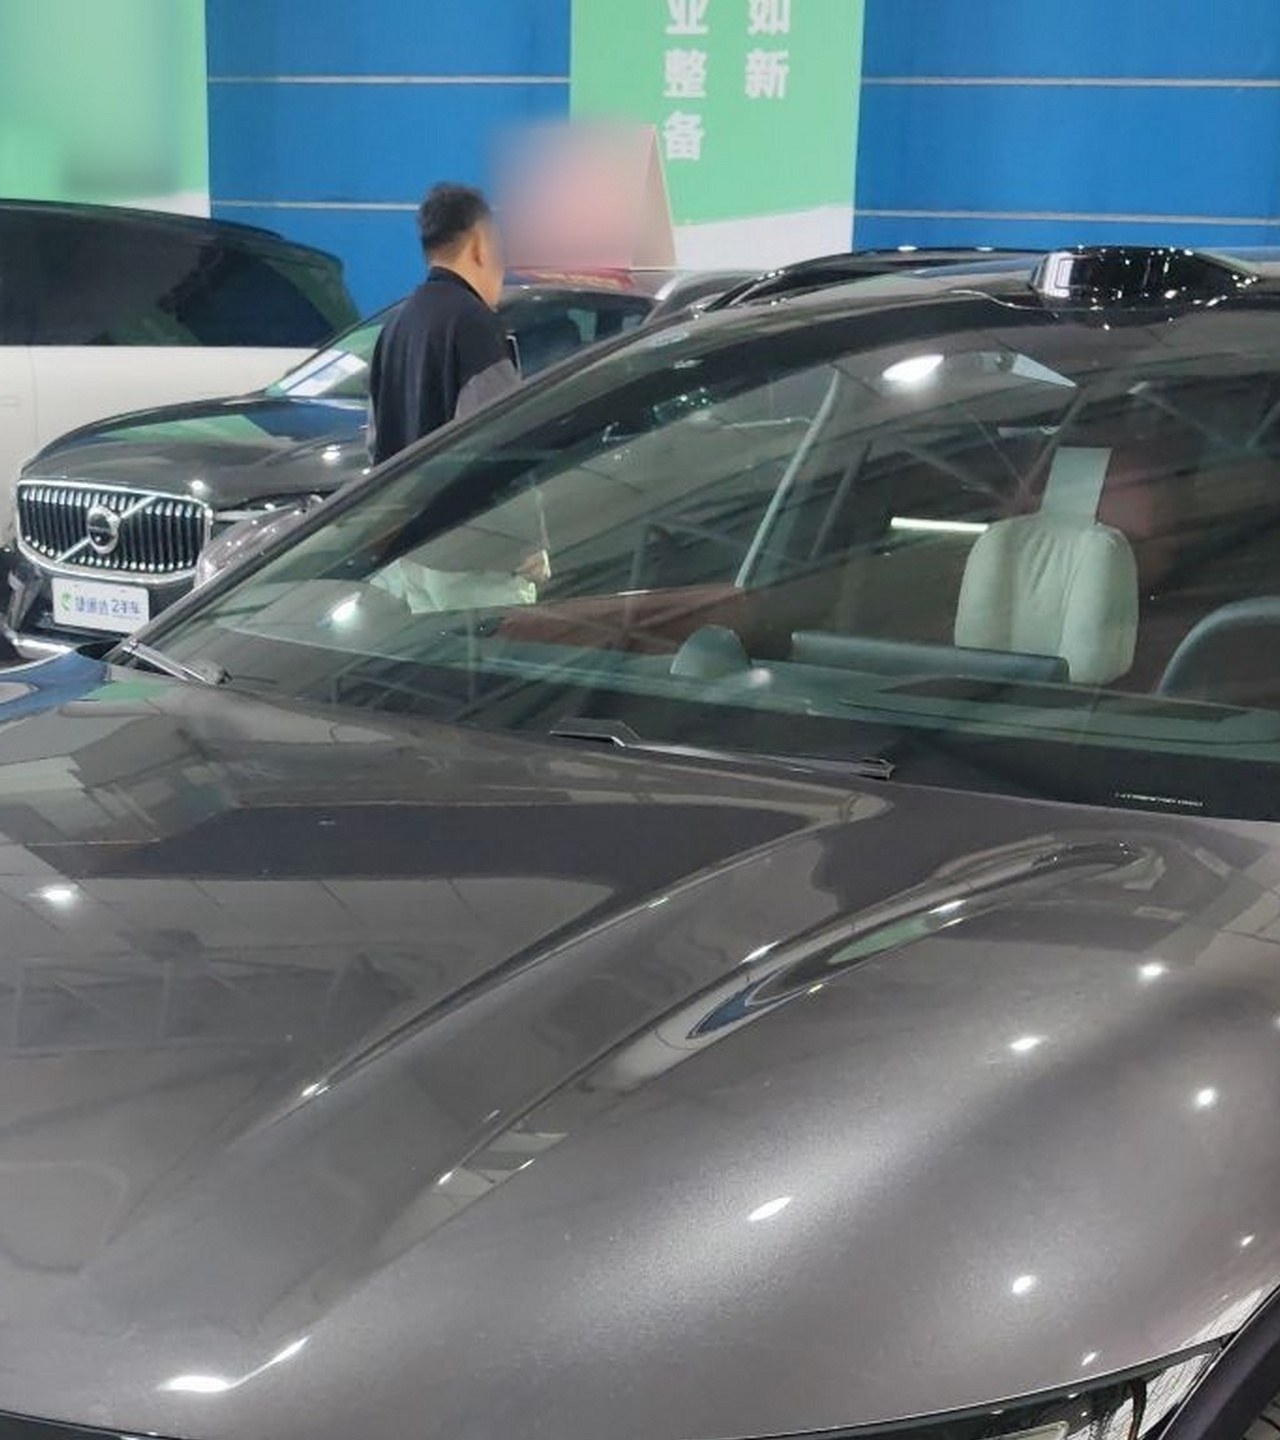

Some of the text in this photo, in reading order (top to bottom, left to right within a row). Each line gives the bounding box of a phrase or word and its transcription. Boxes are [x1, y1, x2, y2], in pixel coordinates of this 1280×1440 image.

[662, 0, 708, 161] 业整备
[745, 0, 791, 98] 如新
